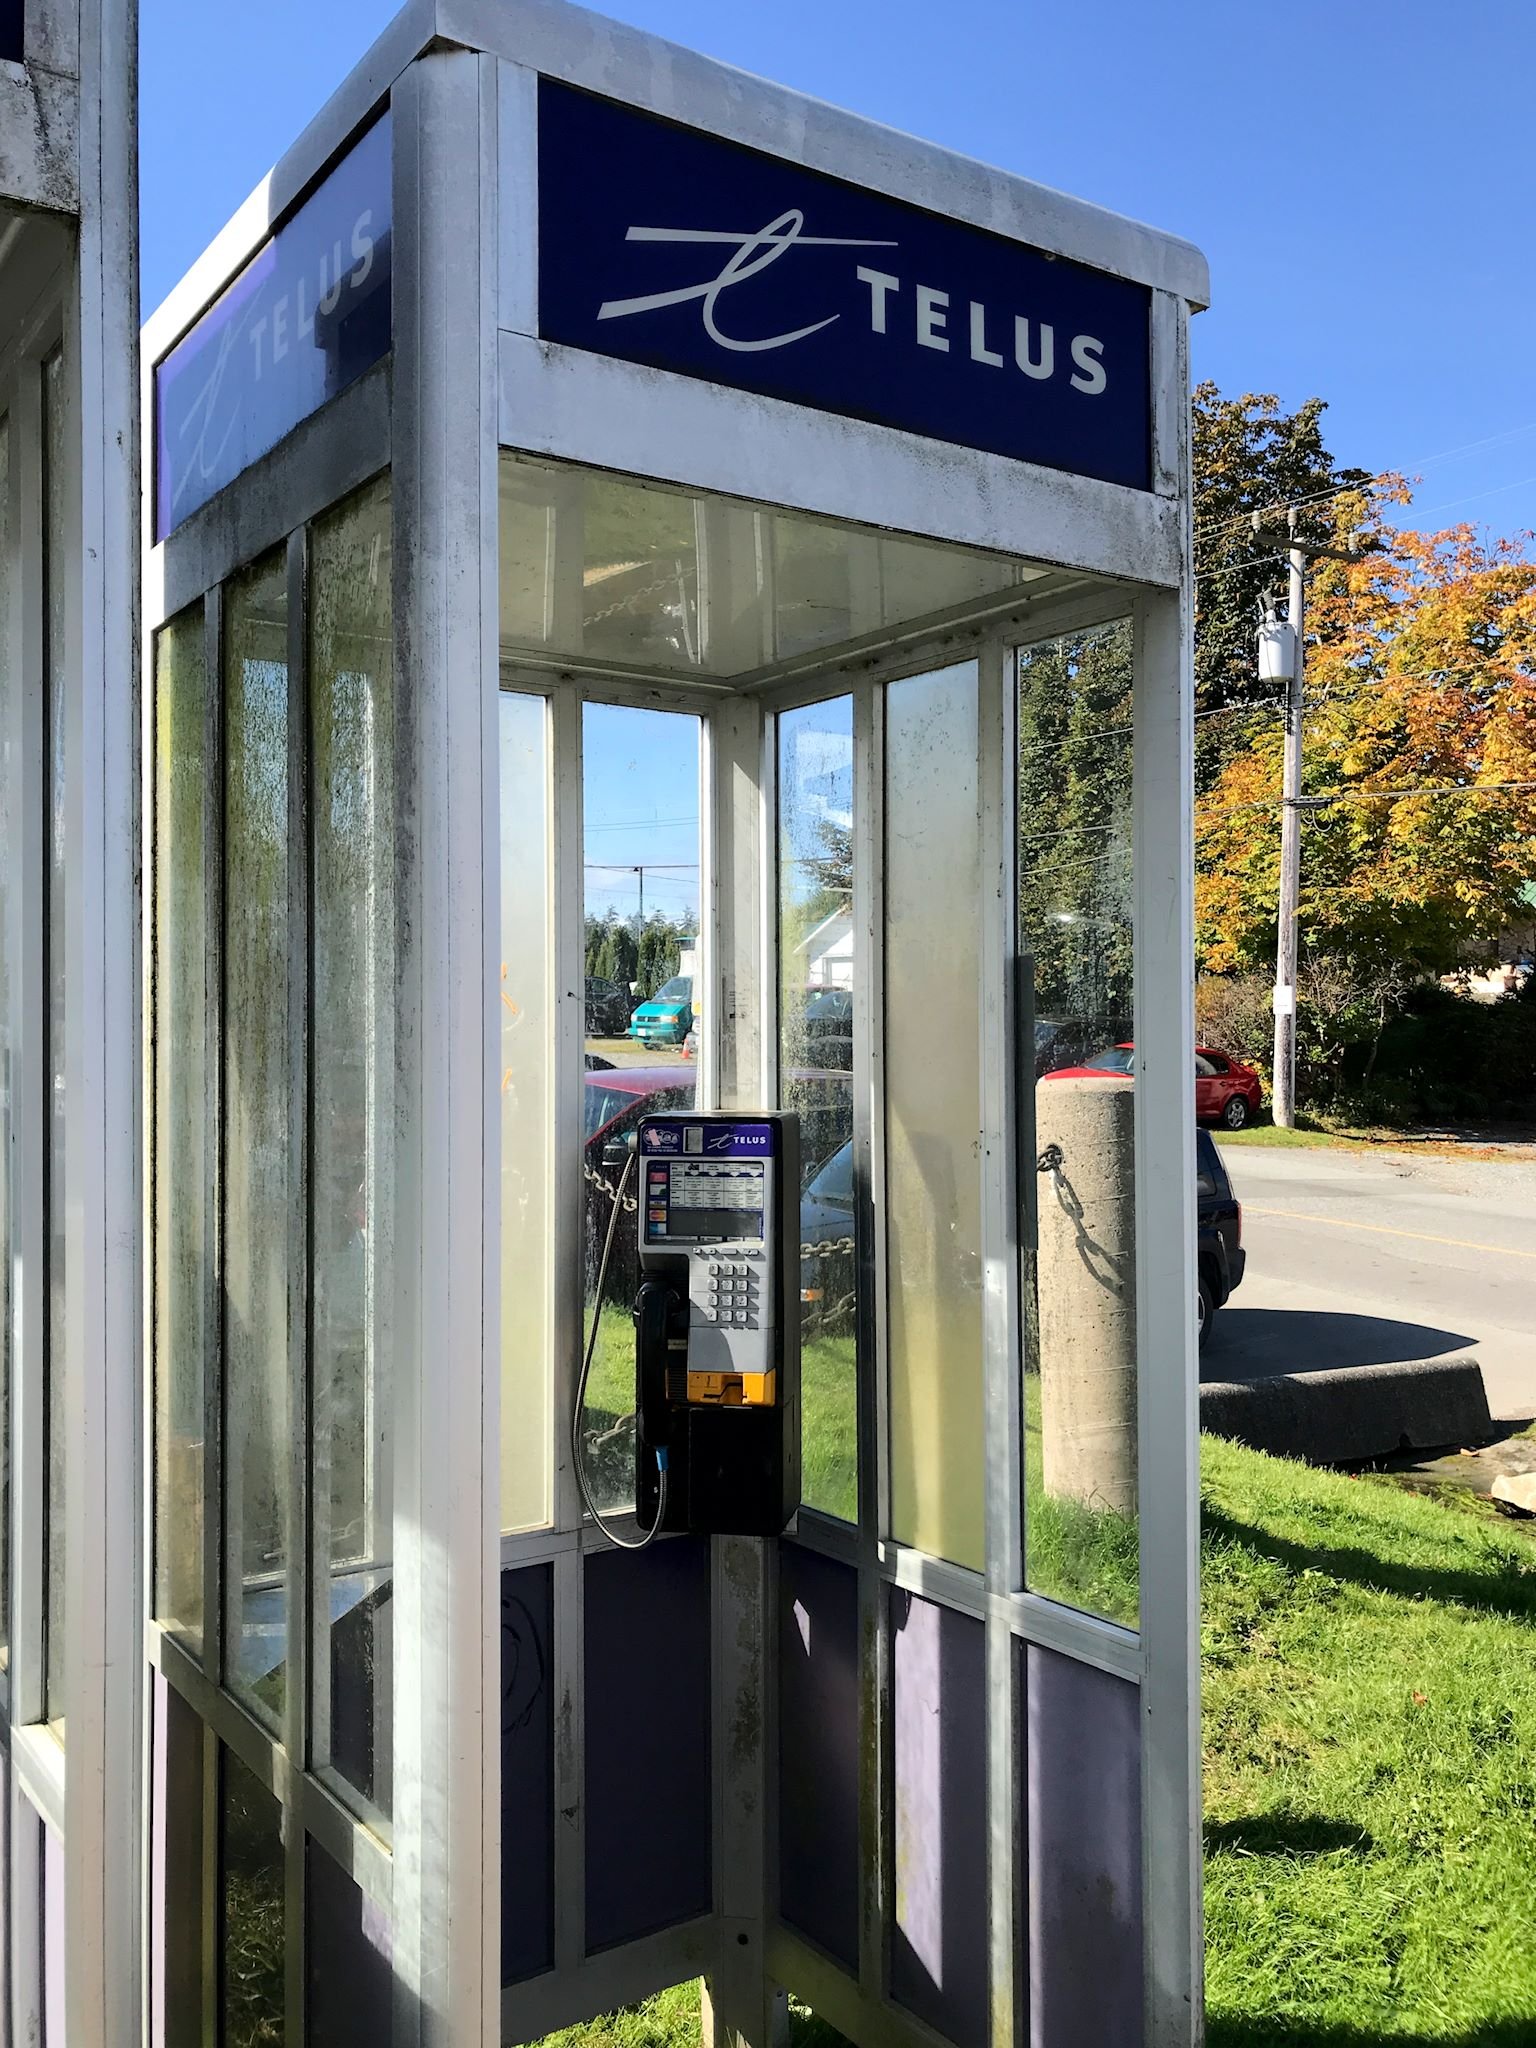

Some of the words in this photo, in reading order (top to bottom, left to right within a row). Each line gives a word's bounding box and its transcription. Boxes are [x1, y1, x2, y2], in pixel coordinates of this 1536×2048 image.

[249, 208, 374, 382] TELUS
[857, 265, 1108, 395] TELUS
[733, 1136, 766, 1145] TELUS
